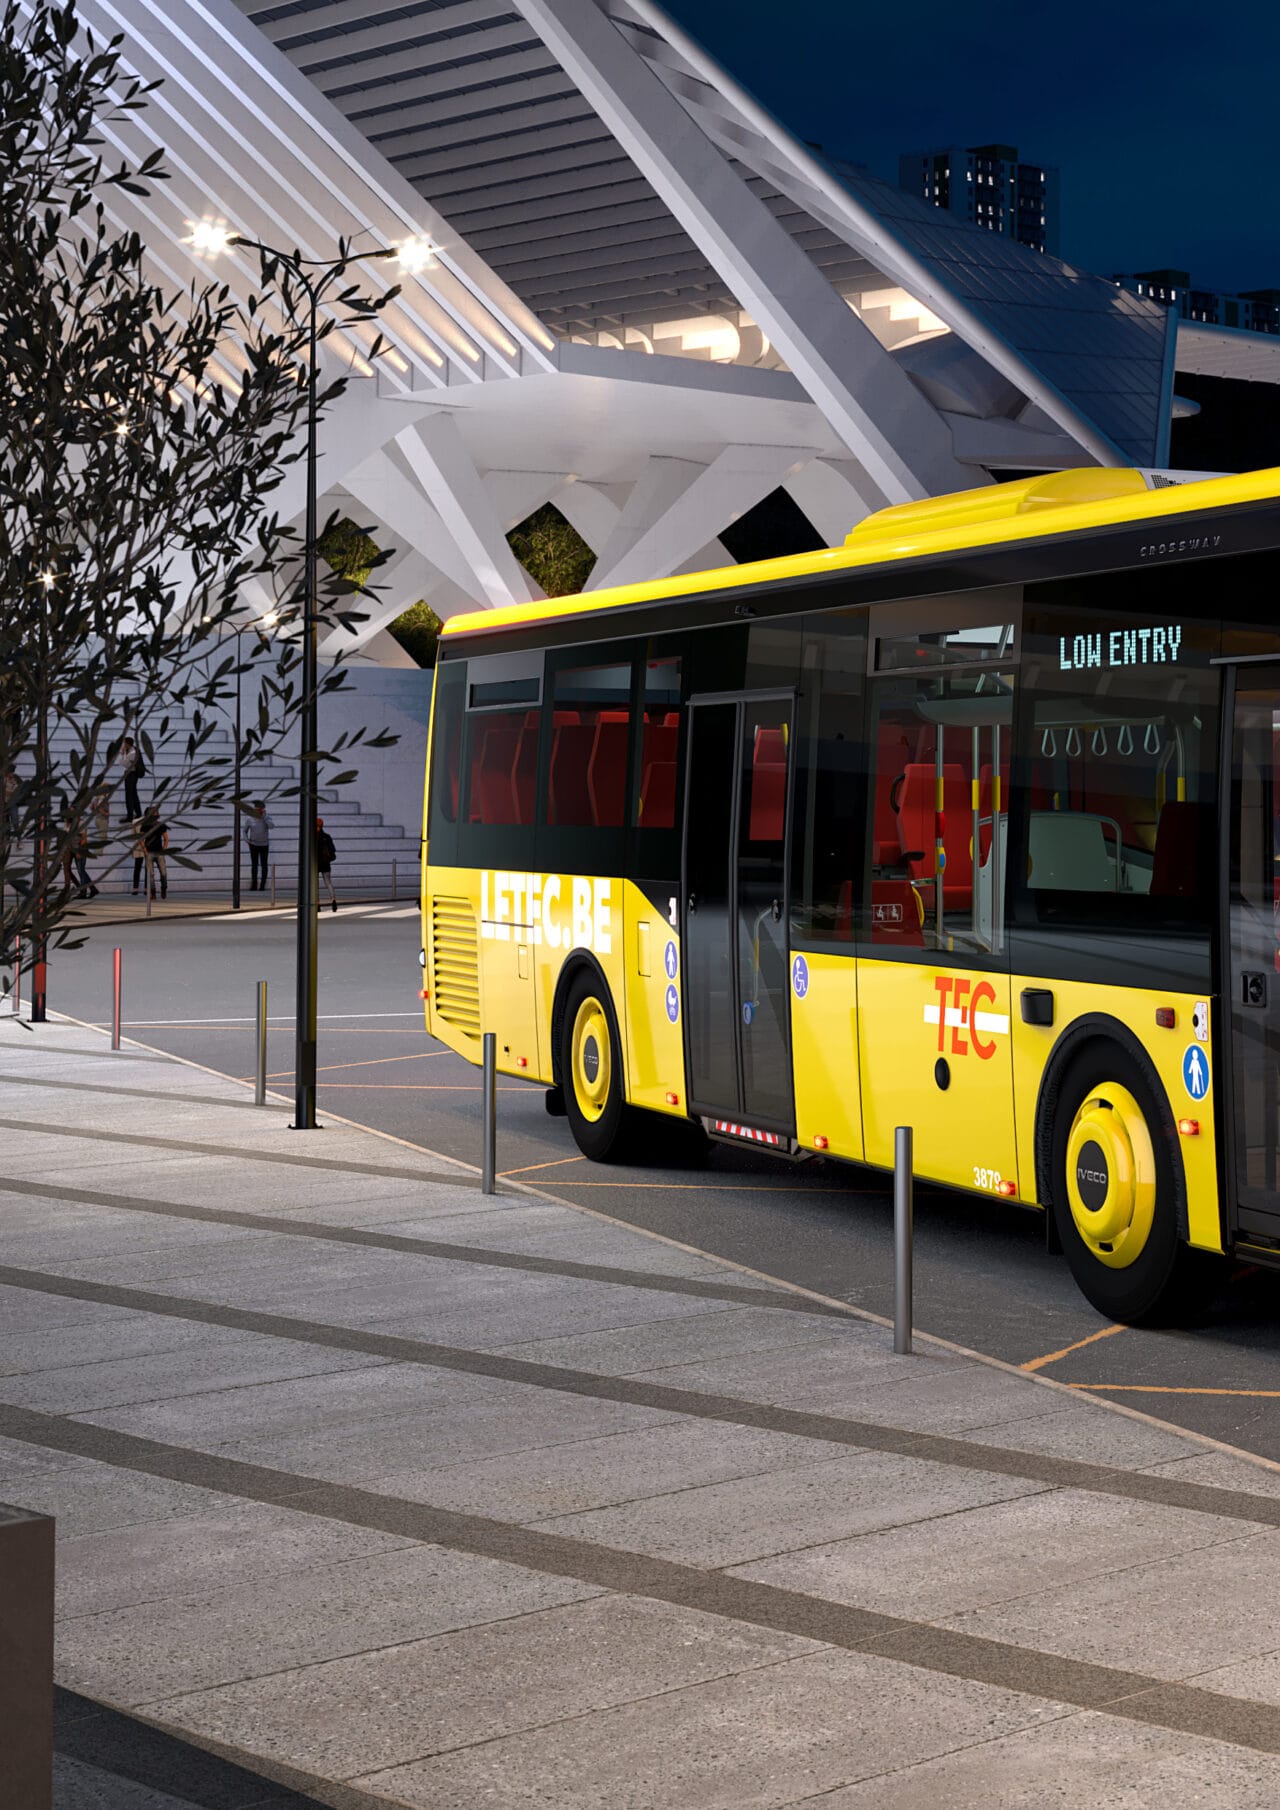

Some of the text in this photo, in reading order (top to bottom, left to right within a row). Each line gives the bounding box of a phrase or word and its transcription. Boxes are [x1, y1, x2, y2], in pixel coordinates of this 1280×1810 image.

[1140, 535, 1221, 557] CROSSWAY
[1060, 625, 1181, 670] LOW ENTRY
[480, 871, 612, 954] LETEC.BE
[934, 975, 998, 1061] TEC
[973, 1166, 1002, 1192] 3879
[1077, 1167, 1107, 1184] IVECO
